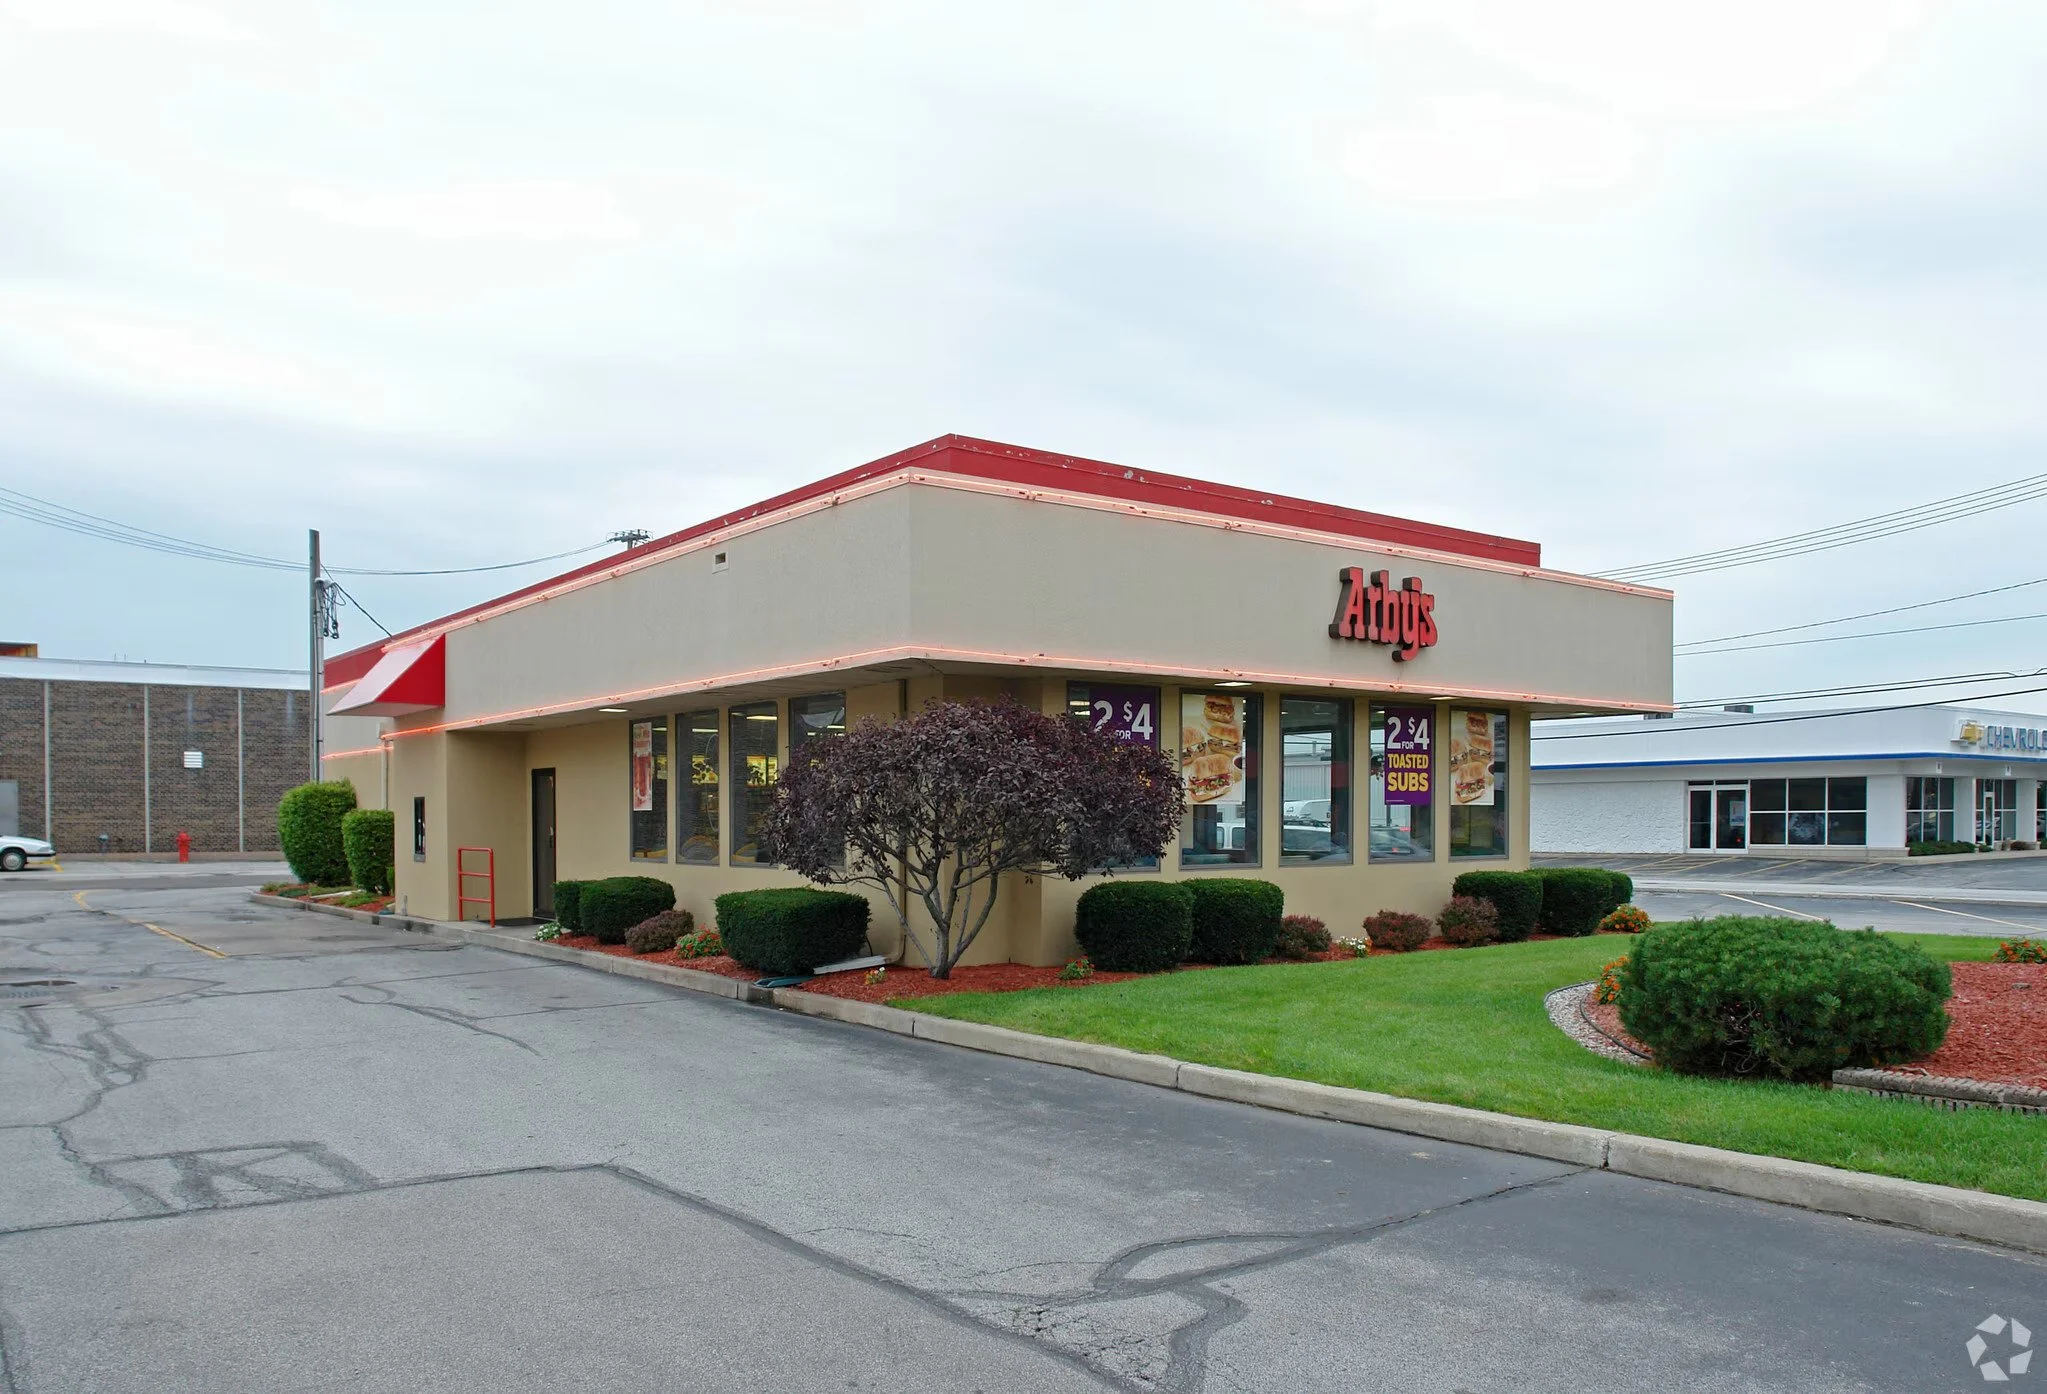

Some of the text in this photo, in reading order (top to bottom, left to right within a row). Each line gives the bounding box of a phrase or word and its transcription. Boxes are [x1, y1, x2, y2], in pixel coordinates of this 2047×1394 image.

[1093, 700, 1113, 732] 2
[1123, 701, 1153, 740] $4
[1387, 716, 1430, 750] 2 FOR $4
[1387, 754, 1429, 769] TOASTED
[1387, 772, 1429, 792] SUBS
